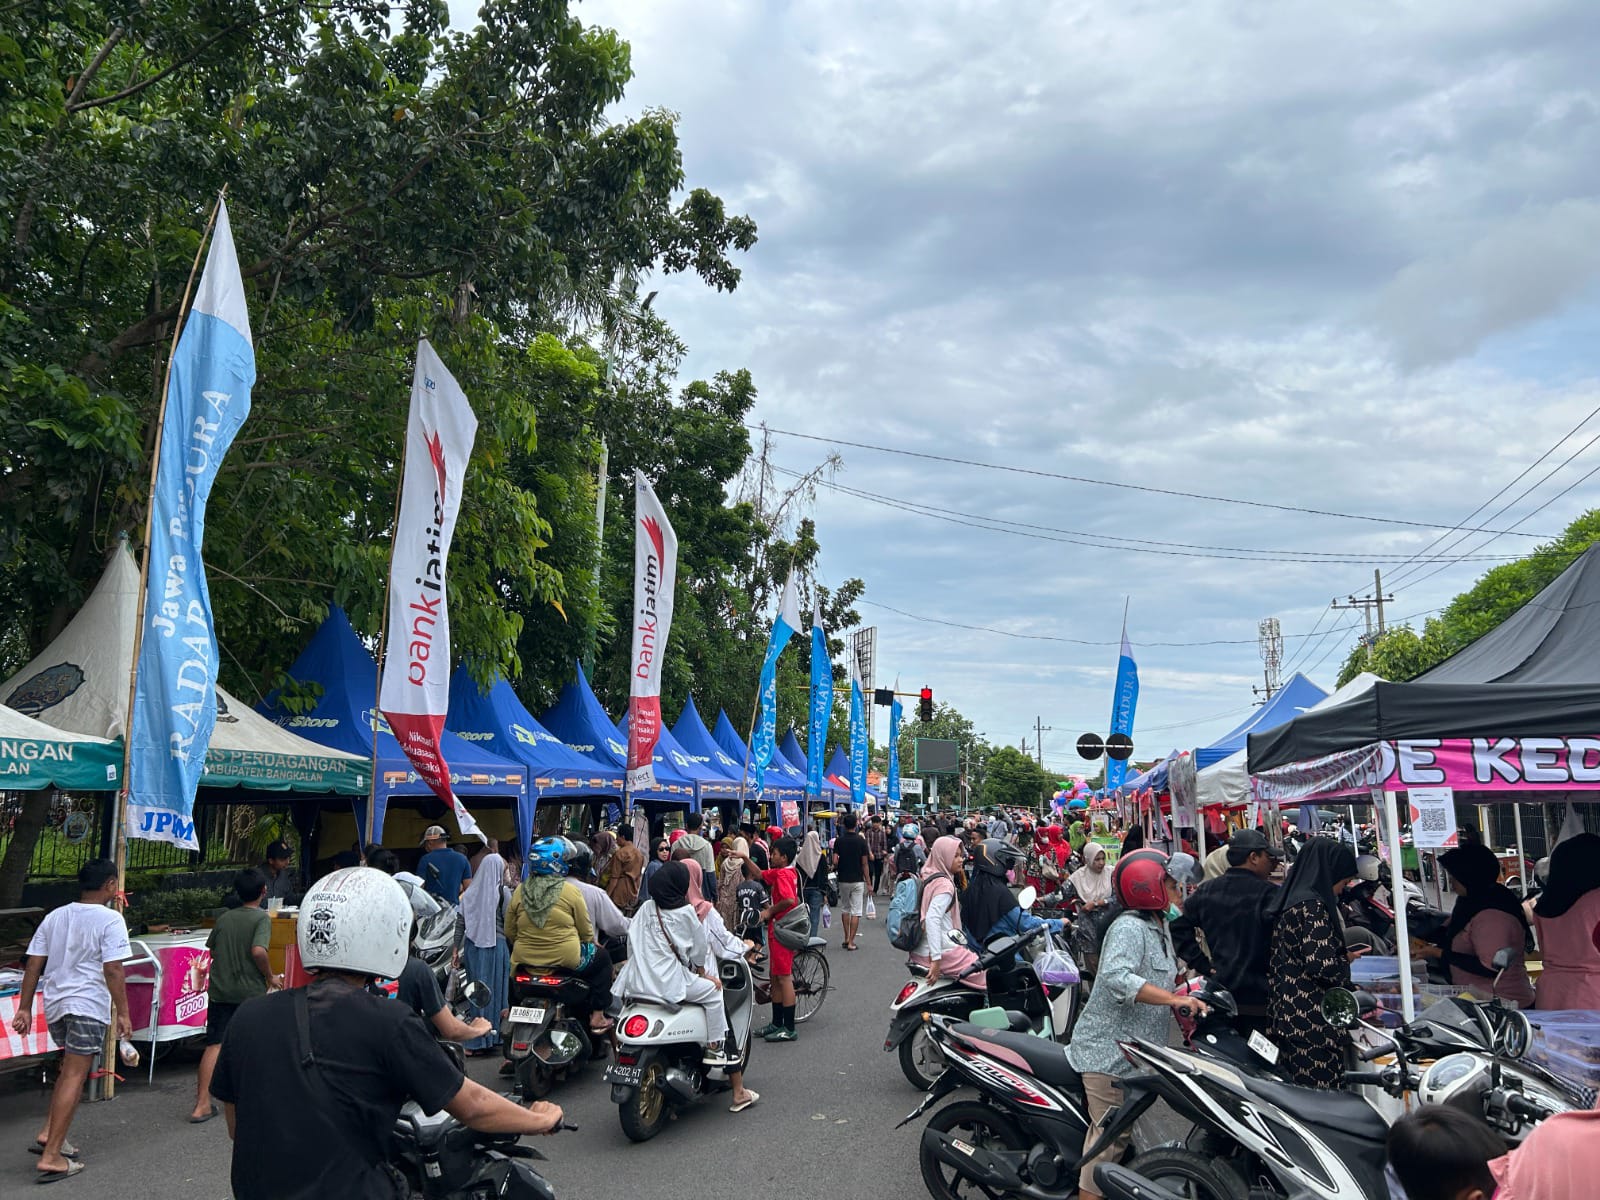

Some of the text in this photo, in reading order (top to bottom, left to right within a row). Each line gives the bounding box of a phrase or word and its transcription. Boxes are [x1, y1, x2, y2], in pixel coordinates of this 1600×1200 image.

[153, 554, 187, 638] Jawa
[636, 554, 657, 680] bankjatim
[1118, 671, 1136, 731] MADURA
[207, 764, 322, 782] ABUPATEN BANGKALAN
[231, 751, 347, 773] PERDAGANGAN
[852, 745, 868, 793] RADAR
[180, 996, 205, 1018] 7.000
[614, 1066, 631, 1077] 4202
[632, 1068, 642, 1078] HT
